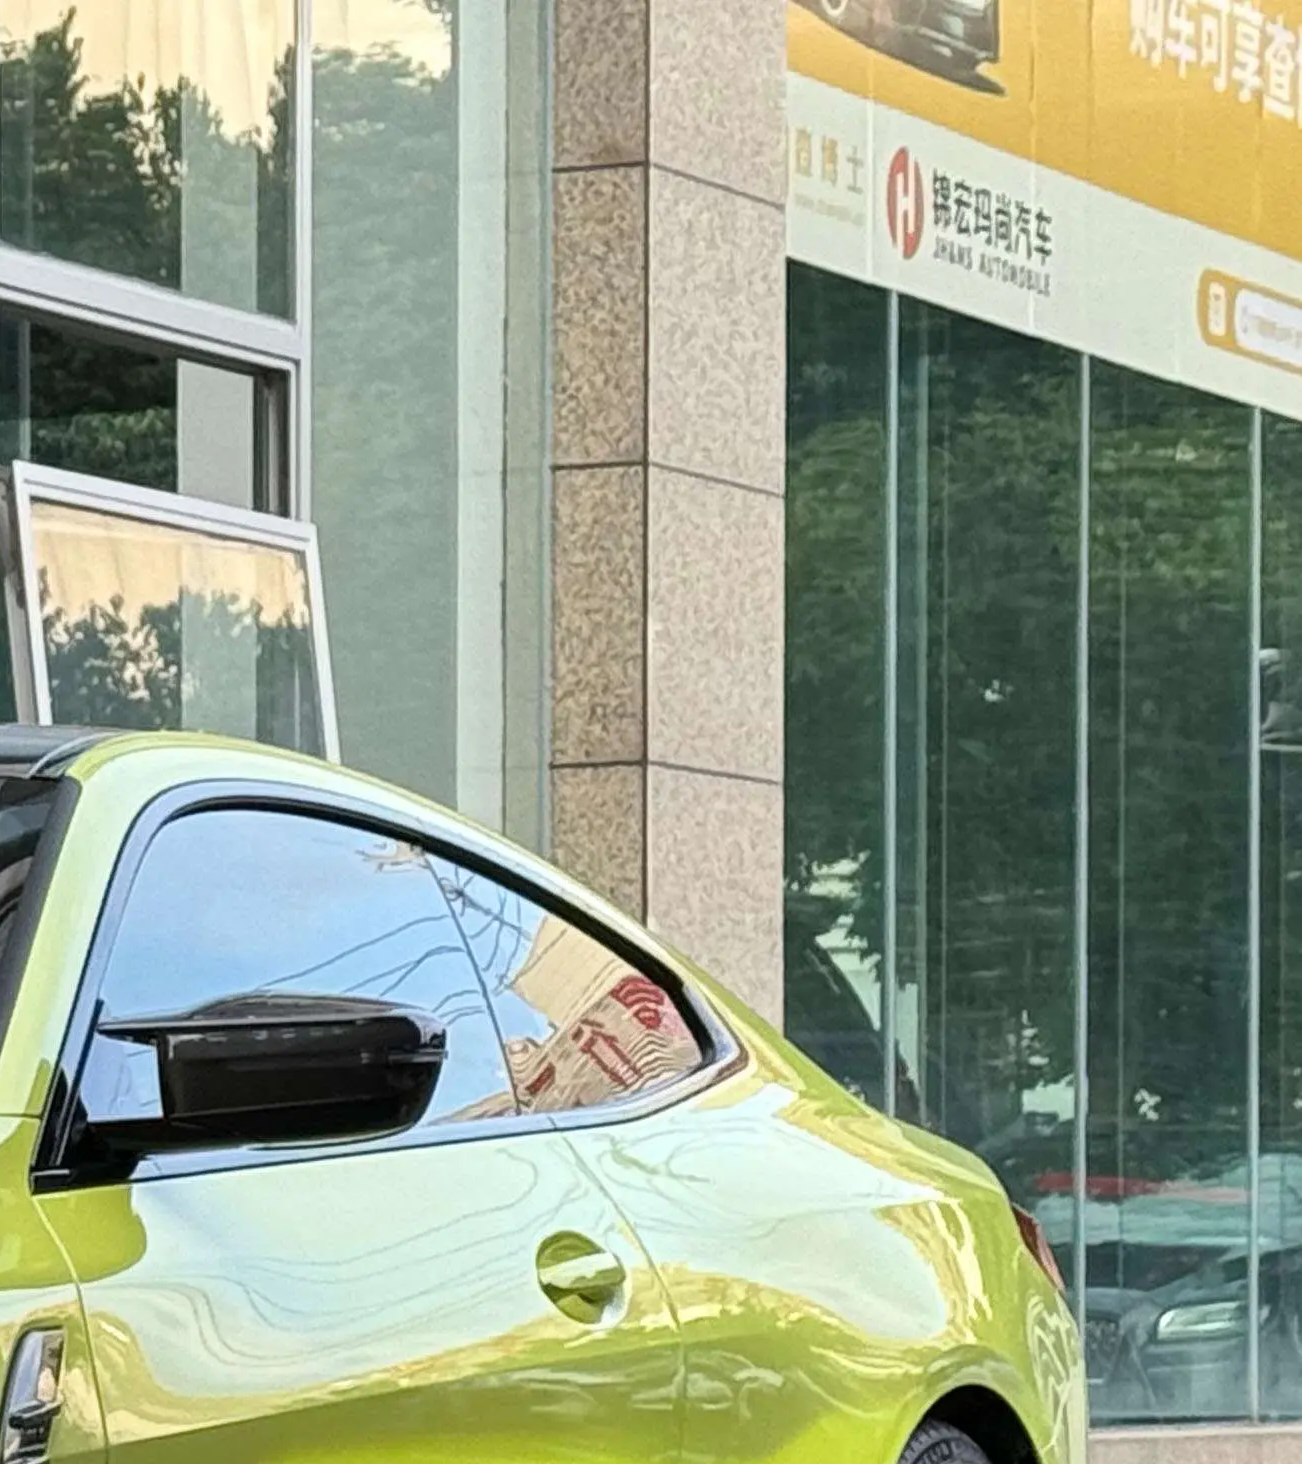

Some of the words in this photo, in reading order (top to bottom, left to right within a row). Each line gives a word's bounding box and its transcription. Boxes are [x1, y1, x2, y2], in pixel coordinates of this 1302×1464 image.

[1129, 0, 1302, 129] 购车可享查
